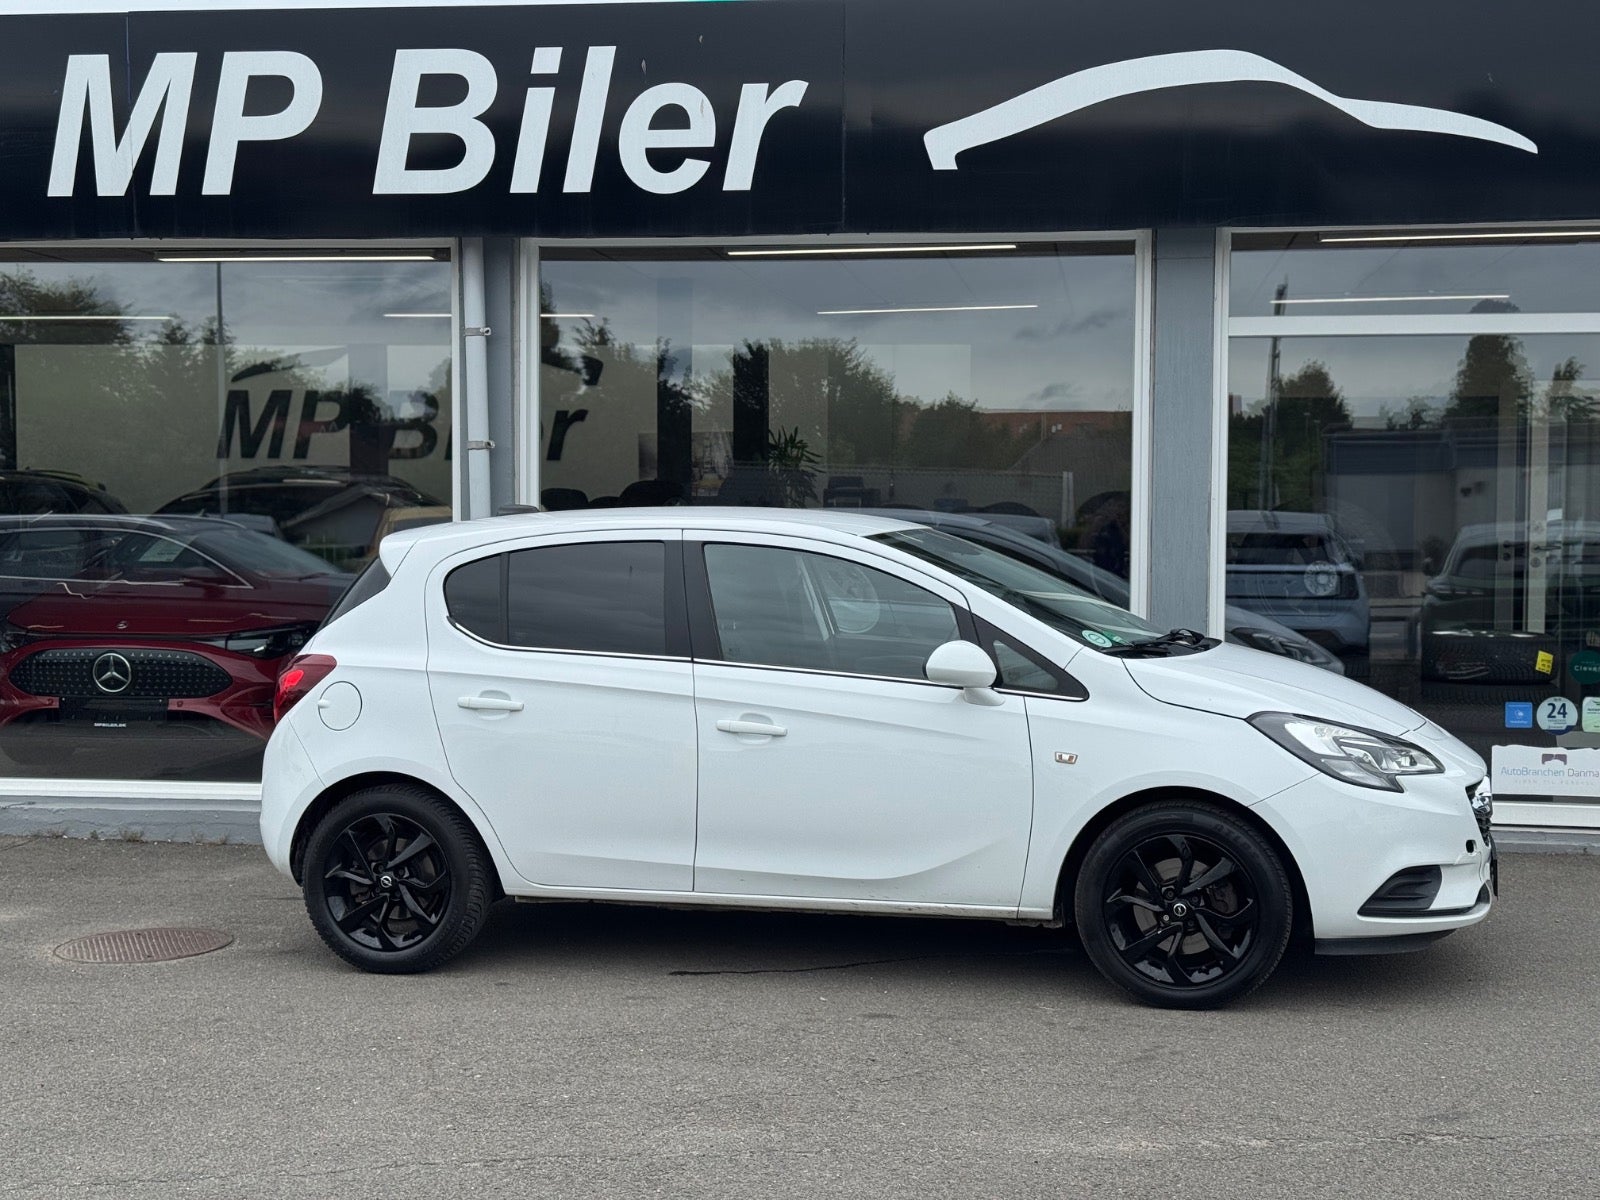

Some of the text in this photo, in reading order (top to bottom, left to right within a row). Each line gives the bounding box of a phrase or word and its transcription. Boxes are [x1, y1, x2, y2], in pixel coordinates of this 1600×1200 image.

[48, 46, 808, 197] MP Biler
[217, 390, 348, 459] MP
[1547, 703, 1567, 718] 24
[1501, 766, 1564, 777] AutoBranchen
